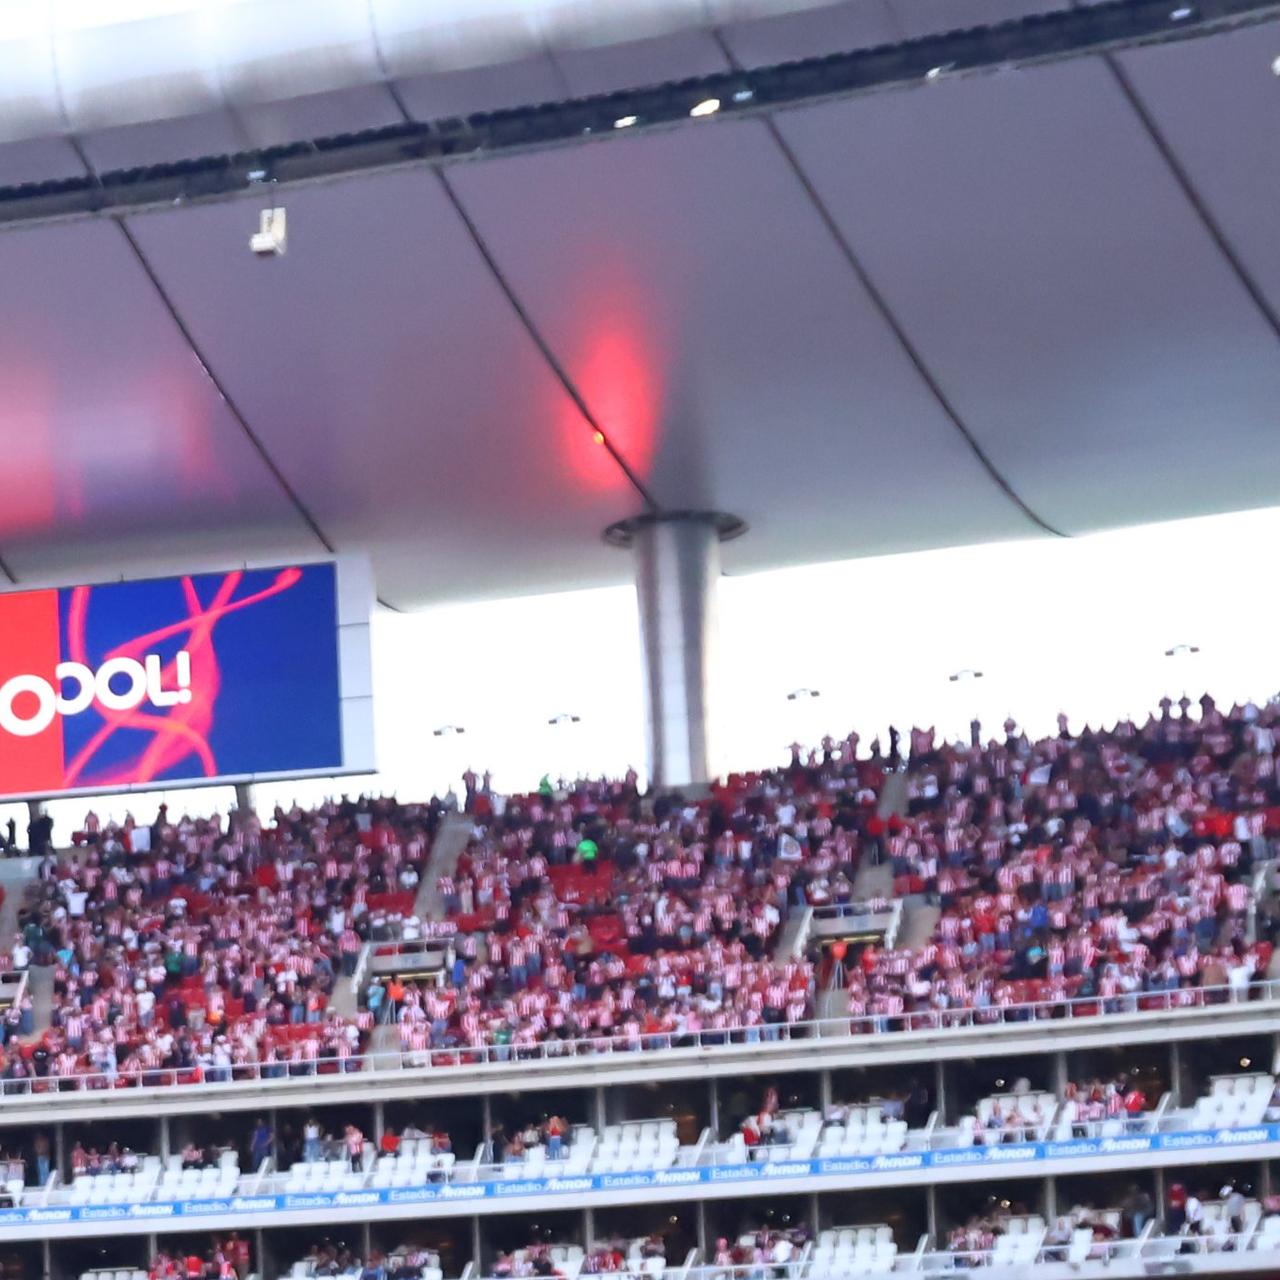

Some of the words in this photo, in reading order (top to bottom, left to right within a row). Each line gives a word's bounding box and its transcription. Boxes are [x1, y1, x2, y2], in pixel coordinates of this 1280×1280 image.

[1163, 1135, 1212, 1147] Estadio
[1049, 1143, 1096, 1156] Estadio
[934, 1151, 982, 1164] Estadio
[822, 1160, 870, 1172] Estadio
[712, 1168, 759, 1180] Estadio
[604, 1175, 650, 1187] Estadio
[496, 1182, 542, 1194] Estadio
[287, 1195, 330, 1207] Estadio
[391, 1189, 435, 1201] Estadio
[82, 1206, 126, 1219] Estadio
[183, 1201, 227, 1213] Estadio
